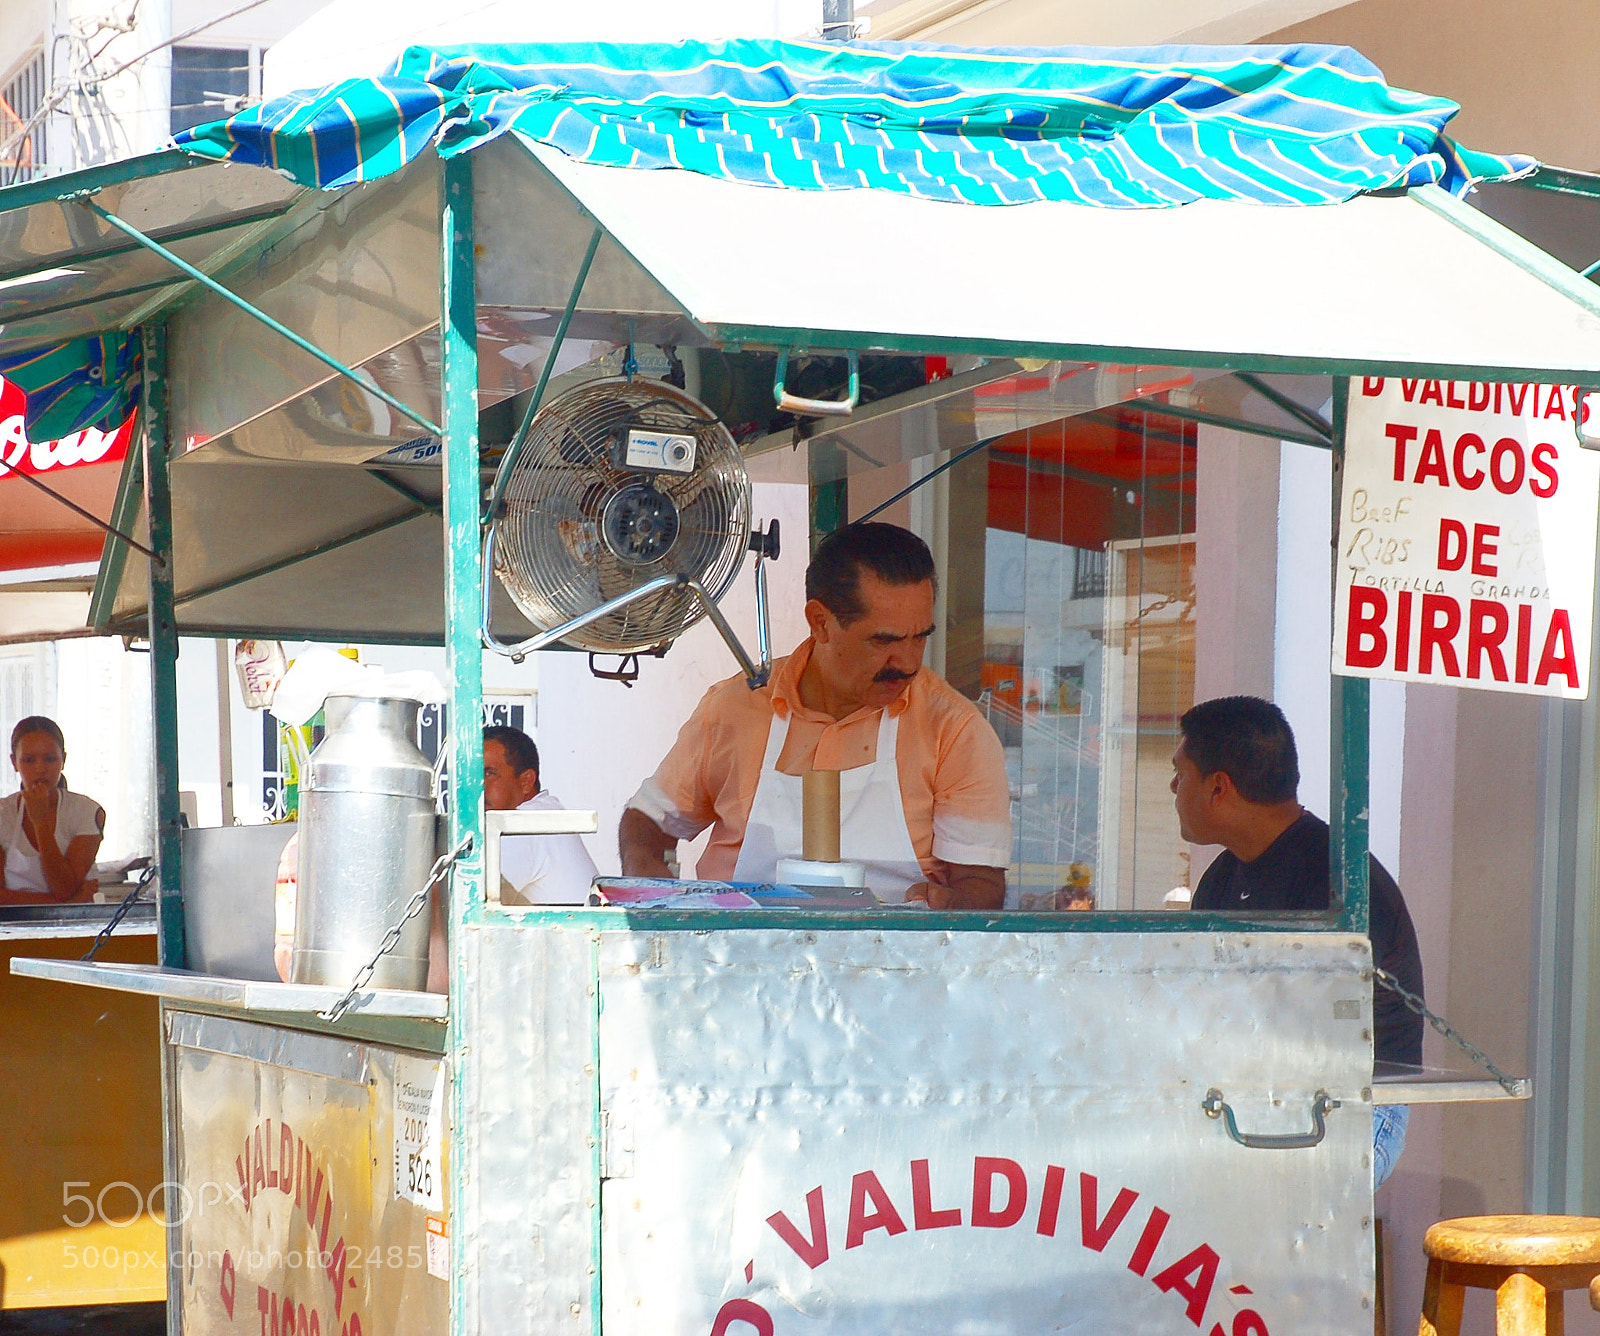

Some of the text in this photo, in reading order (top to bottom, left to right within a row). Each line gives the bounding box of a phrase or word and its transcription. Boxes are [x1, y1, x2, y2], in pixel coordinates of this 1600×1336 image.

[1386, 423, 1559, 498] TACOS
[1437, 518, 1500, 578] DE
[1345, 585, 1580, 689] BIRRIA
[409, 1153, 432, 1197] 526
